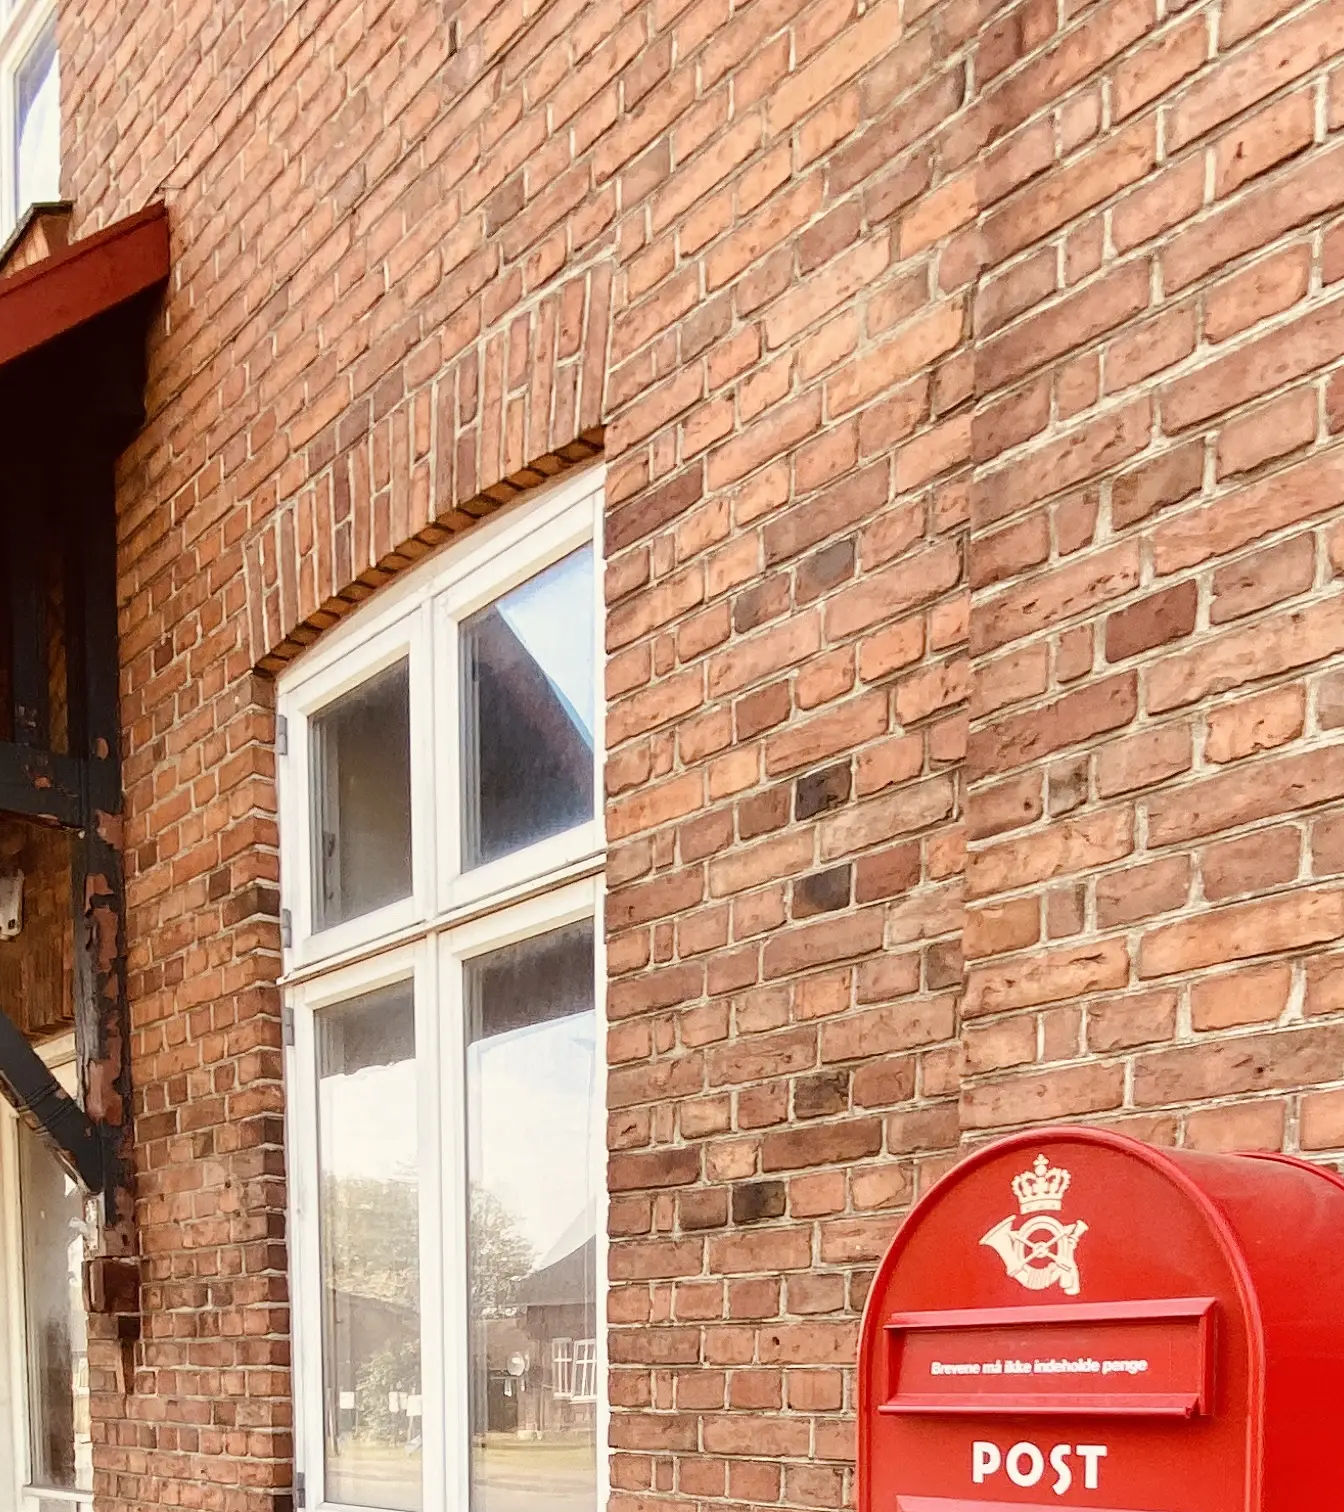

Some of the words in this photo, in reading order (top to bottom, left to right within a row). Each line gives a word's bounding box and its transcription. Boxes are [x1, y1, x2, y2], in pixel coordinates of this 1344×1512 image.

[931, 1361, 981, 1375] Brevene
[982, 1359, 1002, 1374] må
[1004, 1359, 1032, 1374] ikke
[1034, 1357, 1100, 1373] indeholde
[1102, 1359, 1148, 1375] penge
[971, 1440, 1108, 1496] POST
